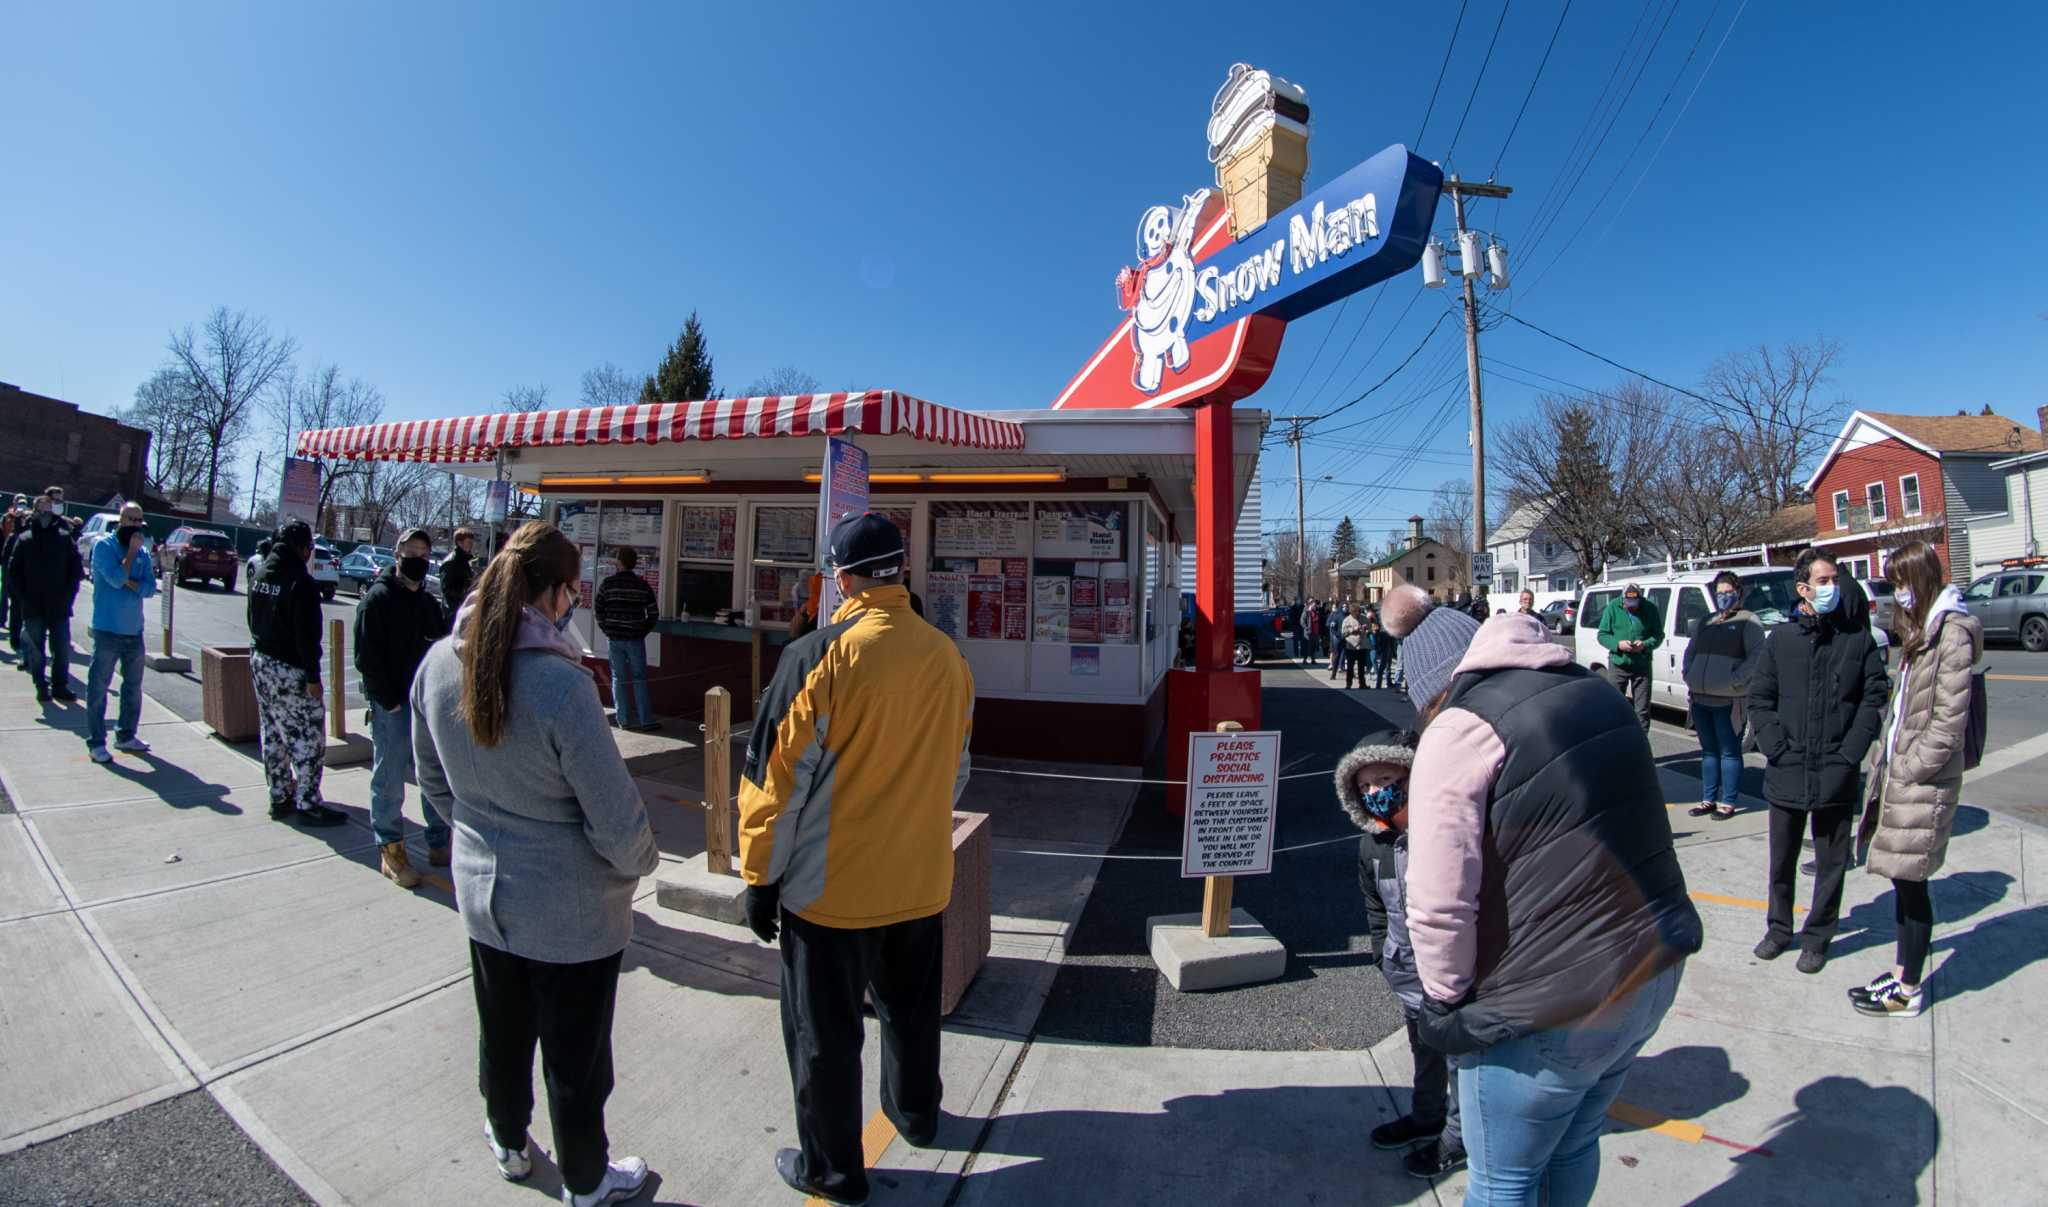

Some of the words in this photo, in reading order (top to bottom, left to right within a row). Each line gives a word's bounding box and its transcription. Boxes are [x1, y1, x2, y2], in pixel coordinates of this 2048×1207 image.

[1194, 239, 1285, 322] Snow
[1289, 193, 1379, 275] Man
[1474, 555, 1490, 563] ONE
[1474, 563, 1490, 572] WAY
[1216, 741, 1256, 750] PLEASE
[1209, 752, 1261, 761] PRACTICE
[1216, 763, 1251, 772] SOCIAL
[1202, 773, 1264, 784] DISTANCING
[1206, 791, 1235, 799] PLEASE
[1194, 809, 1230, 817] BETWEEN
[1232, 808, 1269, 816] YOURSELF
[1212, 817, 1226, 825] THE
[1228, 816, 1269, 825] CUSTOMER
[1239, 842, 1256, 850] NOT
[1201, 852, 1211, 860] BE
[1213, 851, 1243, 859] SERVED
[1244, 850, 1256, 858] AT
[1218, 859, 1254, 867] COUNTER
